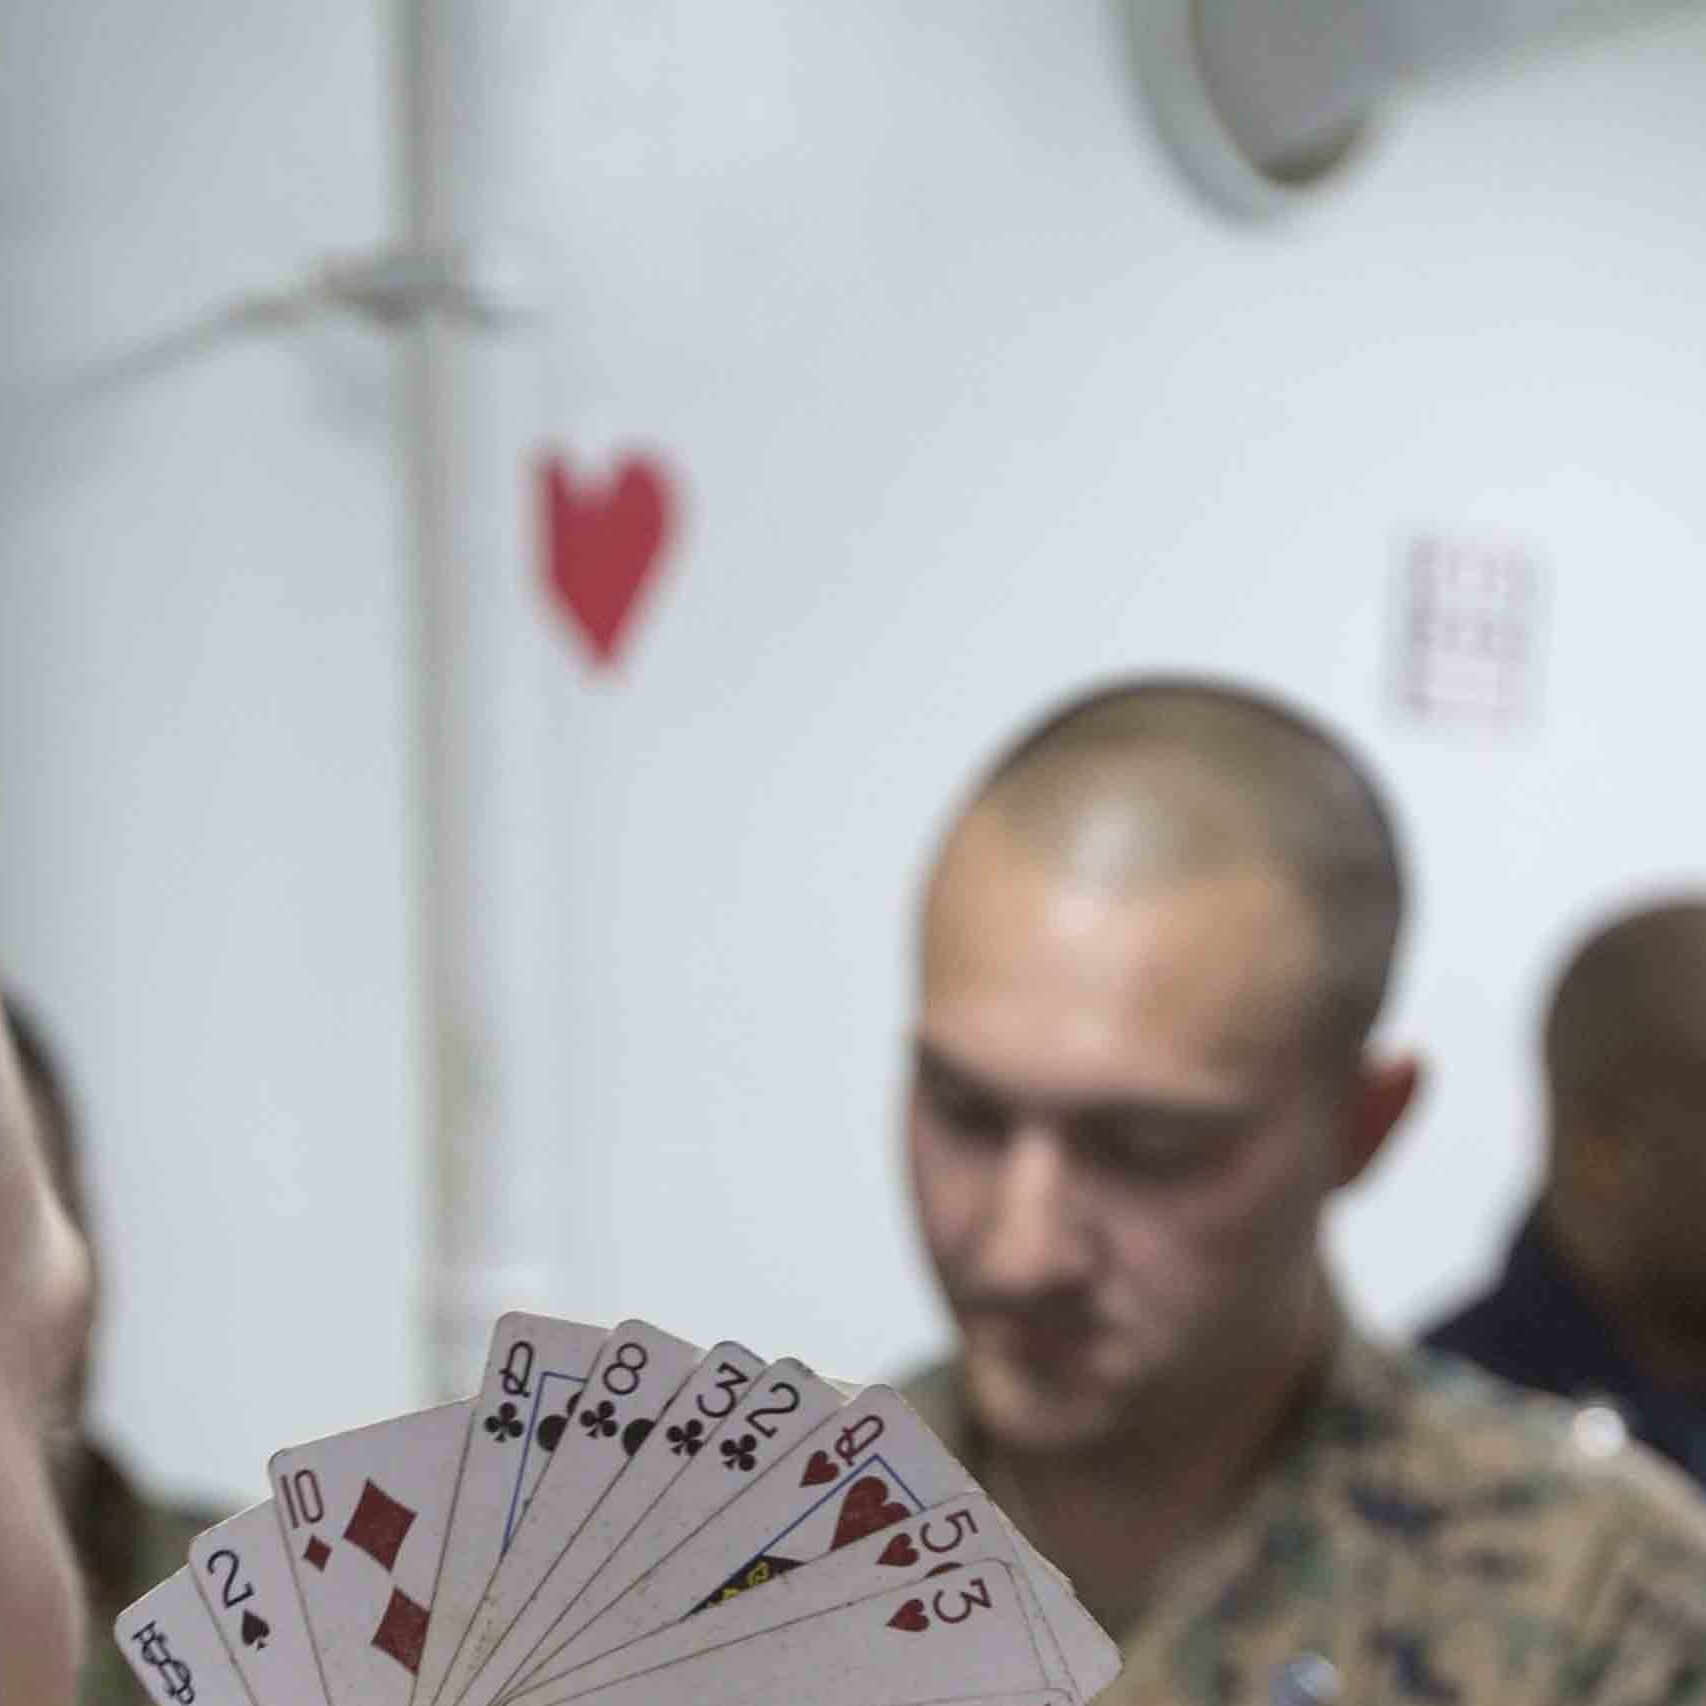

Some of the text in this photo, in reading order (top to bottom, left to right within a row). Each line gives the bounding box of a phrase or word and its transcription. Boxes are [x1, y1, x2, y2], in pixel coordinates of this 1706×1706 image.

[499, 1340, 534, 1398] Q
[603, 1343, 648, 1395] 8
[697, 1362, 750, 1418] 3
[745, 1381, 801, 1438] 2
[834, 1415, 885, 1467] Q
[281, 1469, 326, 1529] 10
[920, 1509, 980, 1553] 5
[206, 1549, 255, 1609] 2
[933, 1577, 992, 1624] 3
